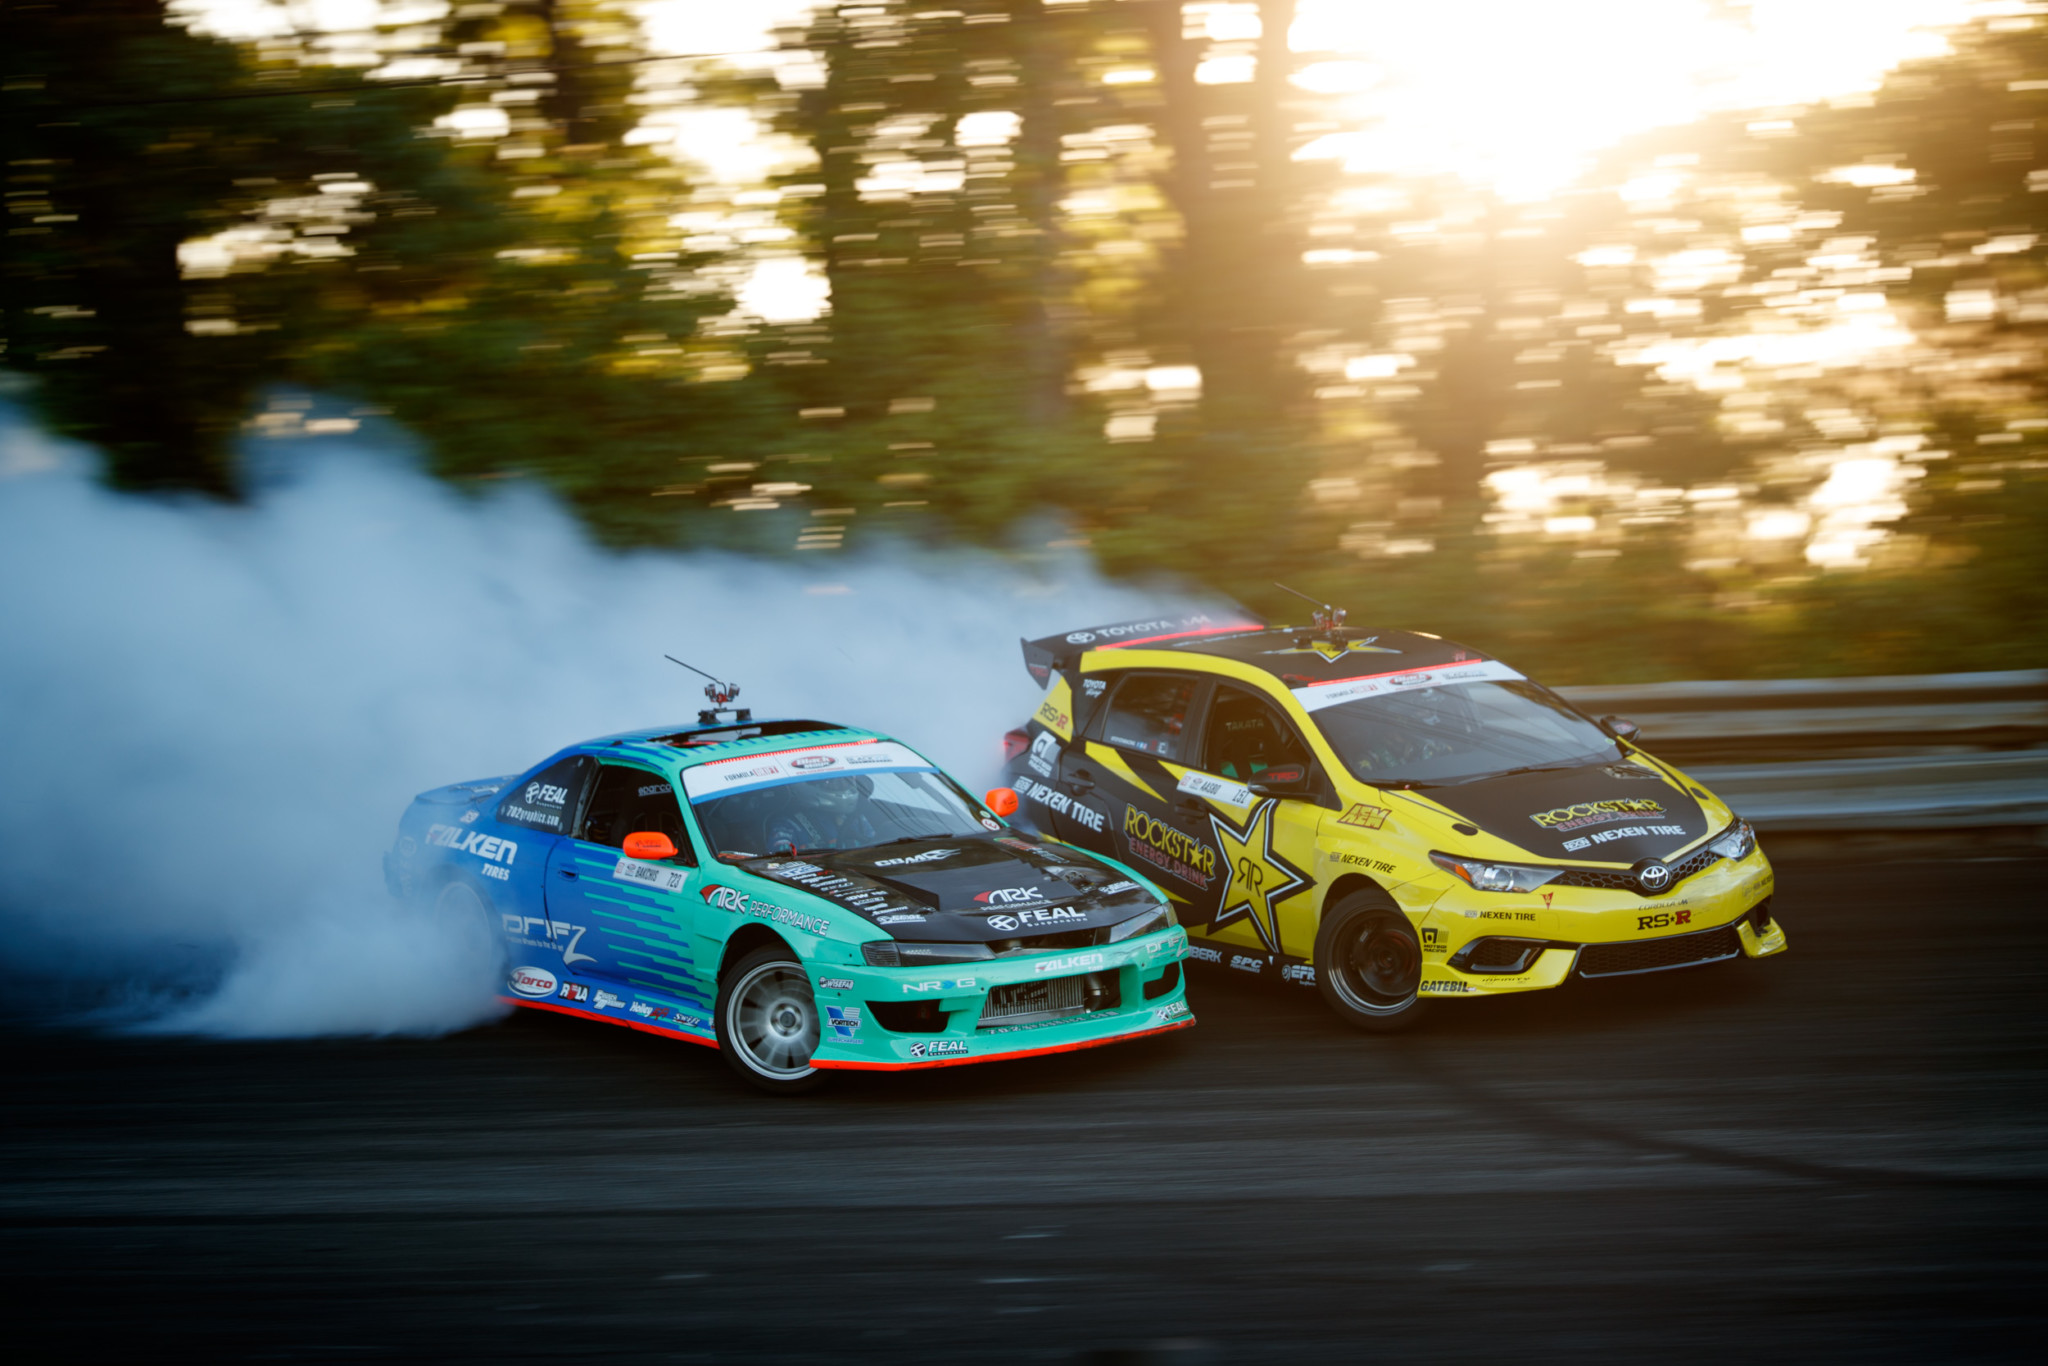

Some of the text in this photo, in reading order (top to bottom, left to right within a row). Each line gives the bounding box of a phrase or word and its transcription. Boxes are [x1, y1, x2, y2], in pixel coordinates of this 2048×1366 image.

[1096, 620, 1175, 638] TOYOTA
[1083, 679, 1106, 690] TOYOTA
[1268, 771, 1298, 782] TRD
[538, 784, 568, 805] FEAL
[1026, 782, 1072, 814] NEXEN
[1071, 801, 1105, 832] TIRE
[1556, 812, 1613, 831] ENERGY
[1590, 826, 1648, 844] NEXEN
[1647, 825, 1687, 836] TIRE
[425, 824, 518, 865] FALKEN
[481, 863, 511, 881] TIRES
[1340, 853, 1373, 868] NEXEN
[1372, 861, 1397, 874] TIRE
[667, 872, 683, 889] 723
[1173, 860, 1208, 888] DRINK
[988, 887, 1044, 904] ARK
[706, 886, 830, 936] ARK PERFORMANCE
[1018, 906, 1087, 923] FEAL
[1480, 911, 1512, 920] NEXEN
[1514, 912, 1537, 921] TIRE
[1035, 953, 1103, 973] FALKEN
[1231, 955, 1263, 969] SPC
[1291, 965, 1316, 980] EFR
[1420, 980, 1469, 993] GATEBIL
[630, 1001, 654, 1018] Holley
[1166, 1001, 1188, 1017] FEAL
[674, 1013, 700, 1024] Swift
[831, 1019, 859, 1027] VORTECH
[928, 1040, 968, 1052] FEAL
